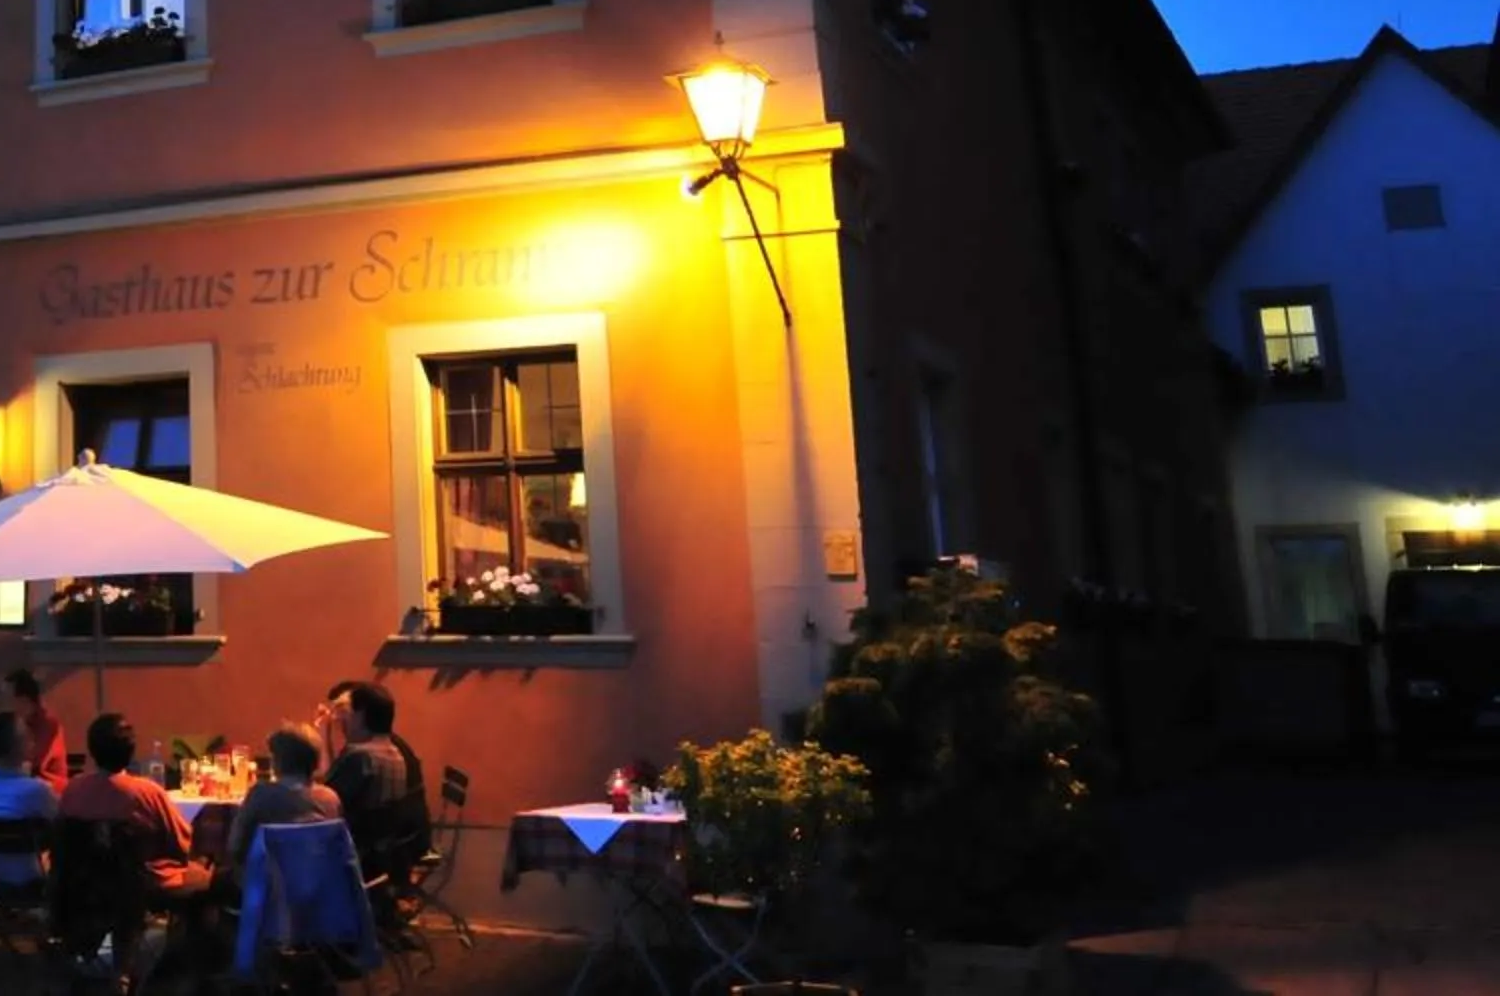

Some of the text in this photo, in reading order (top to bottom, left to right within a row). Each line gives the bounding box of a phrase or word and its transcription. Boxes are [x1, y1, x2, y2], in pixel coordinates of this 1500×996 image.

[39, 229, 546, 325] Gasthaus zur Schran
